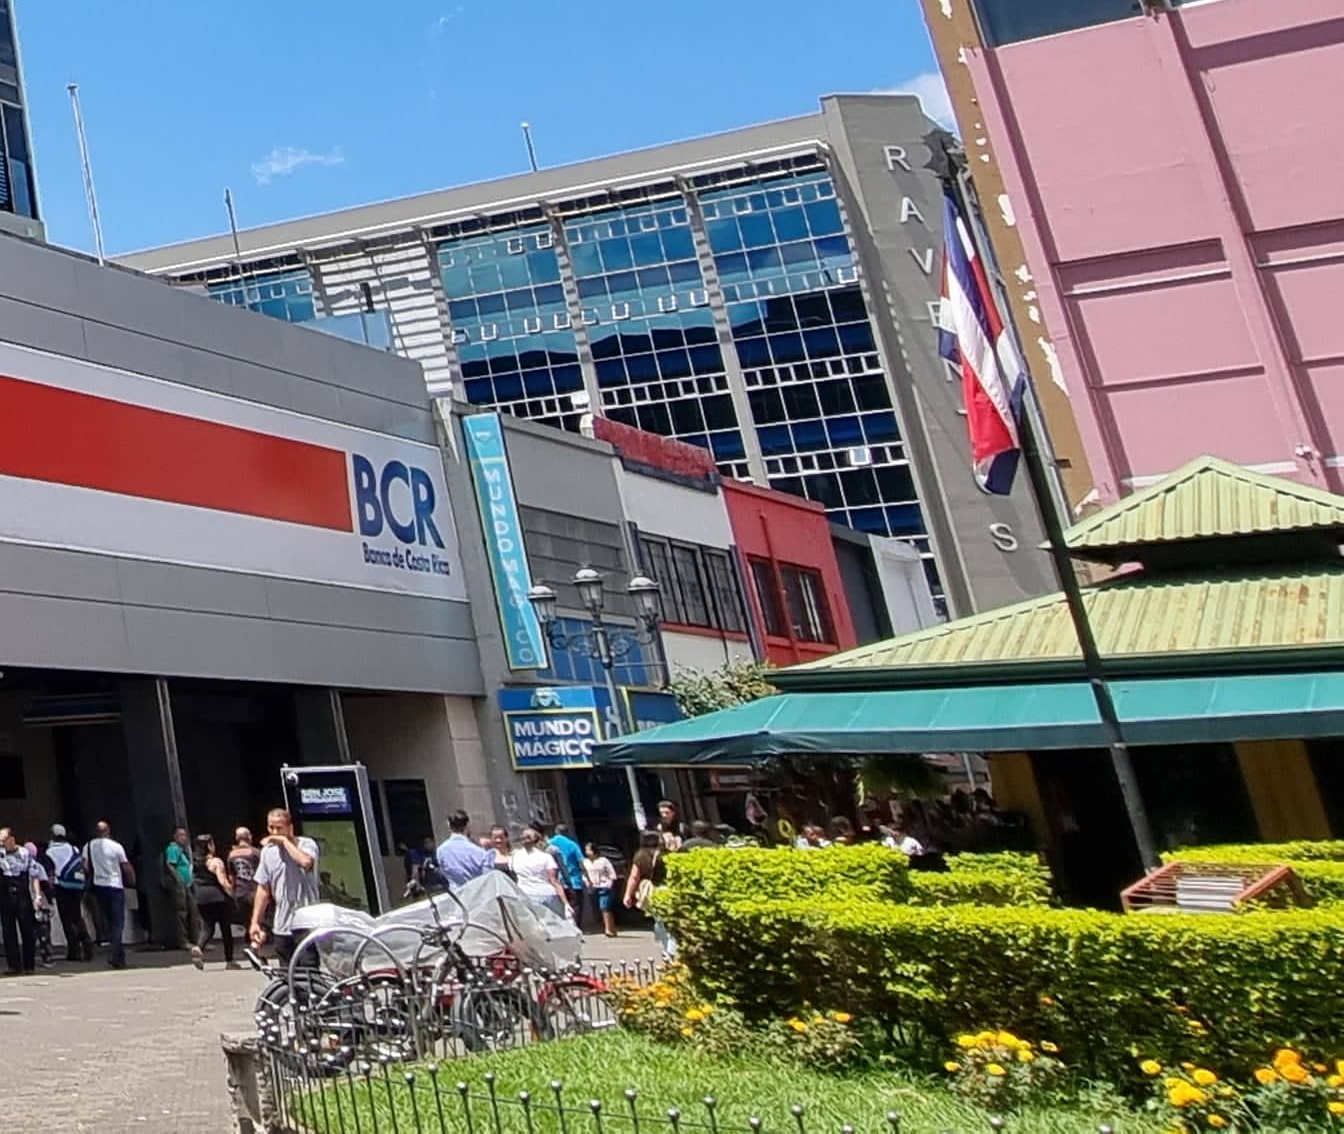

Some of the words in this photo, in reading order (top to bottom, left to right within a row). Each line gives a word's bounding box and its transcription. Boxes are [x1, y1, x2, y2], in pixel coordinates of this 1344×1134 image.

[352, 452, 446, 550] BCR
[484, 468, 514, 553] MUNDO
[514, 718, 592, 737] MUNDO
